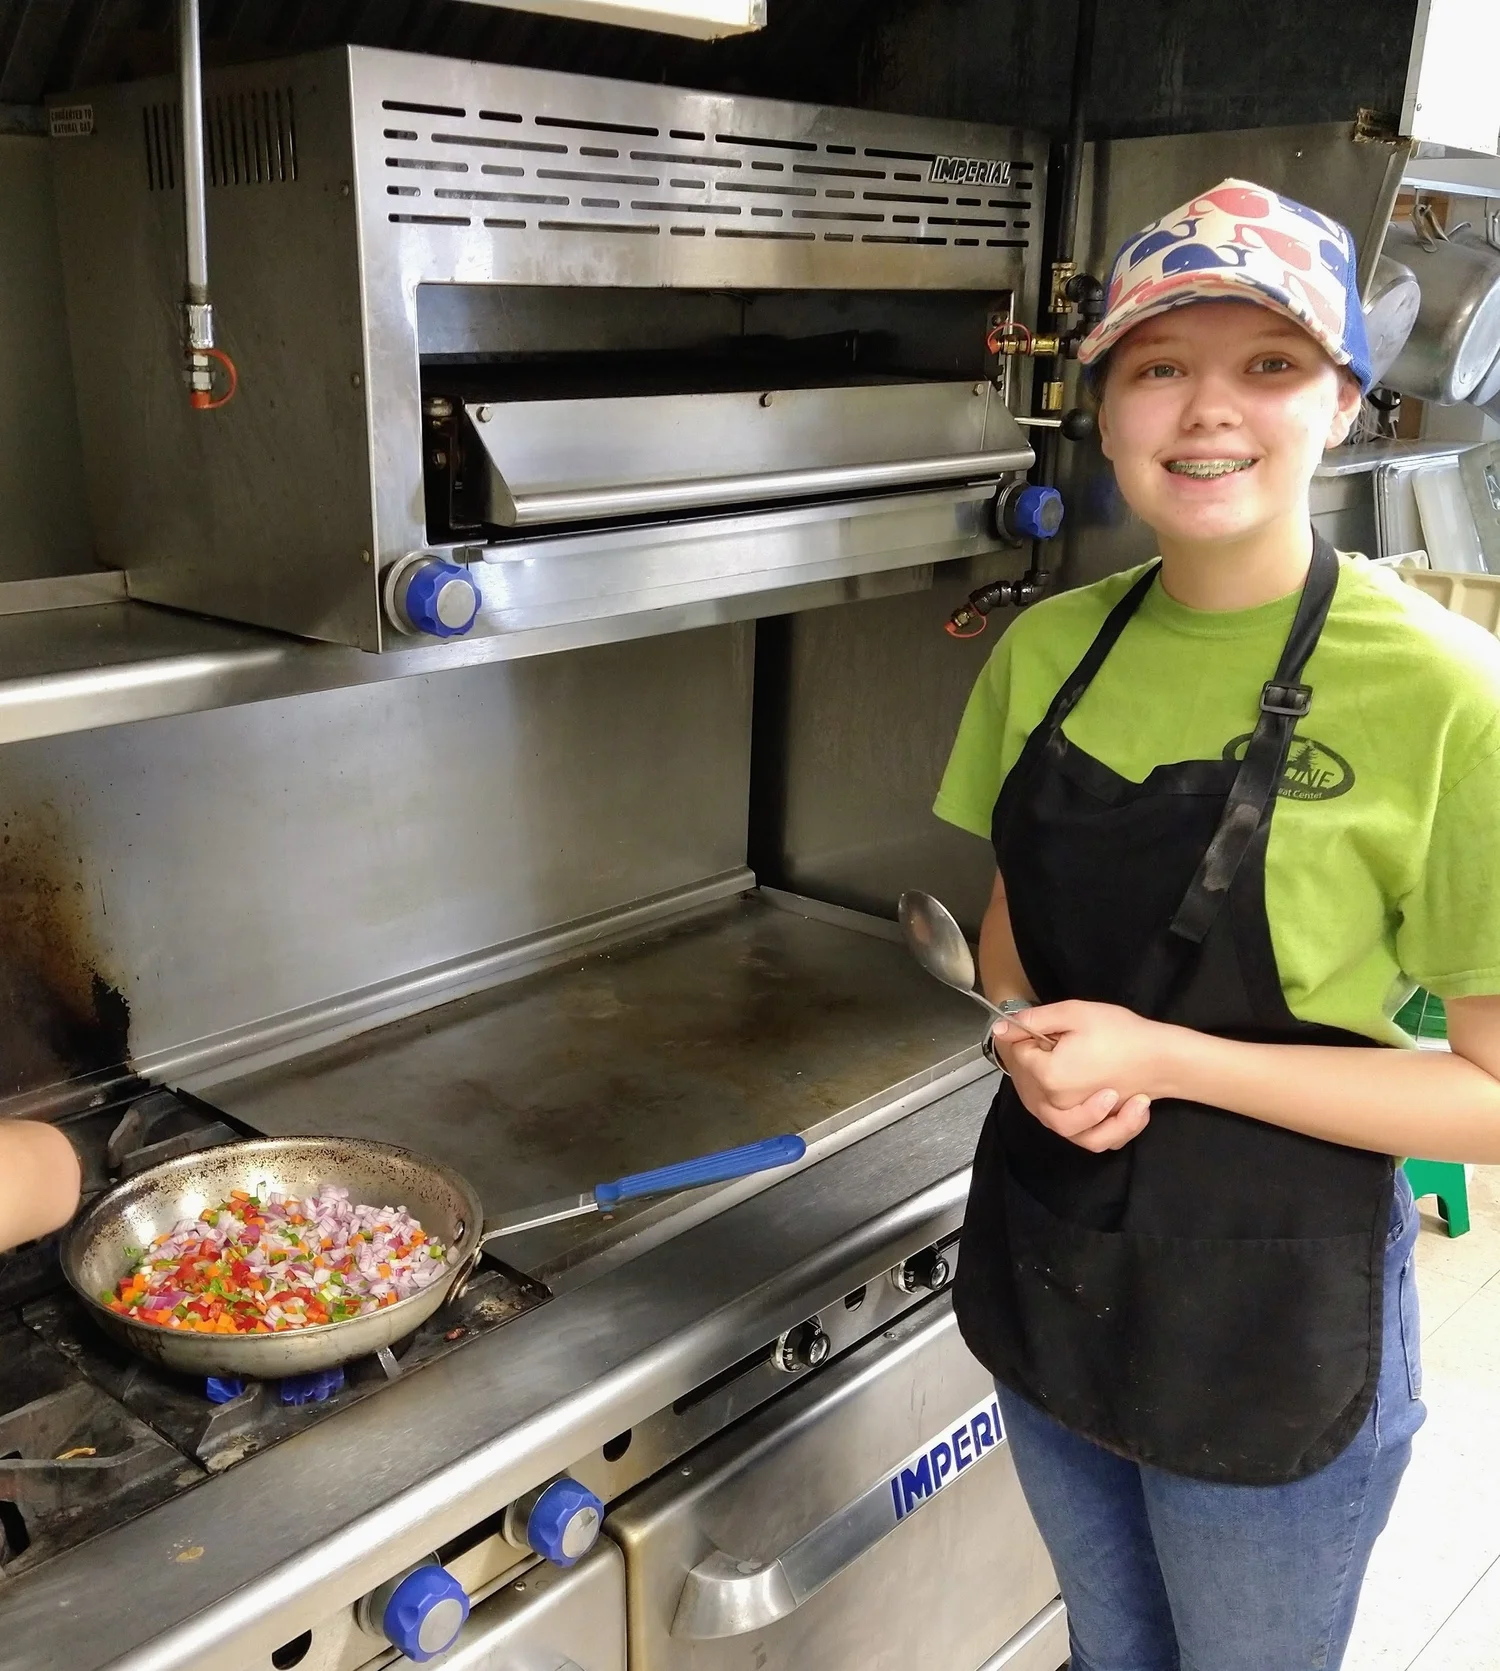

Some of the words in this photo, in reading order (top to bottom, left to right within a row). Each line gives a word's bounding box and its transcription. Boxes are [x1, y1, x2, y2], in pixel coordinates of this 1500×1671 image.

[929, 155, 1011, 187] IMPERIAL
[1293, 789, 1323, 799] Center
[891, 1401, 1003, 1521] IMPERI
